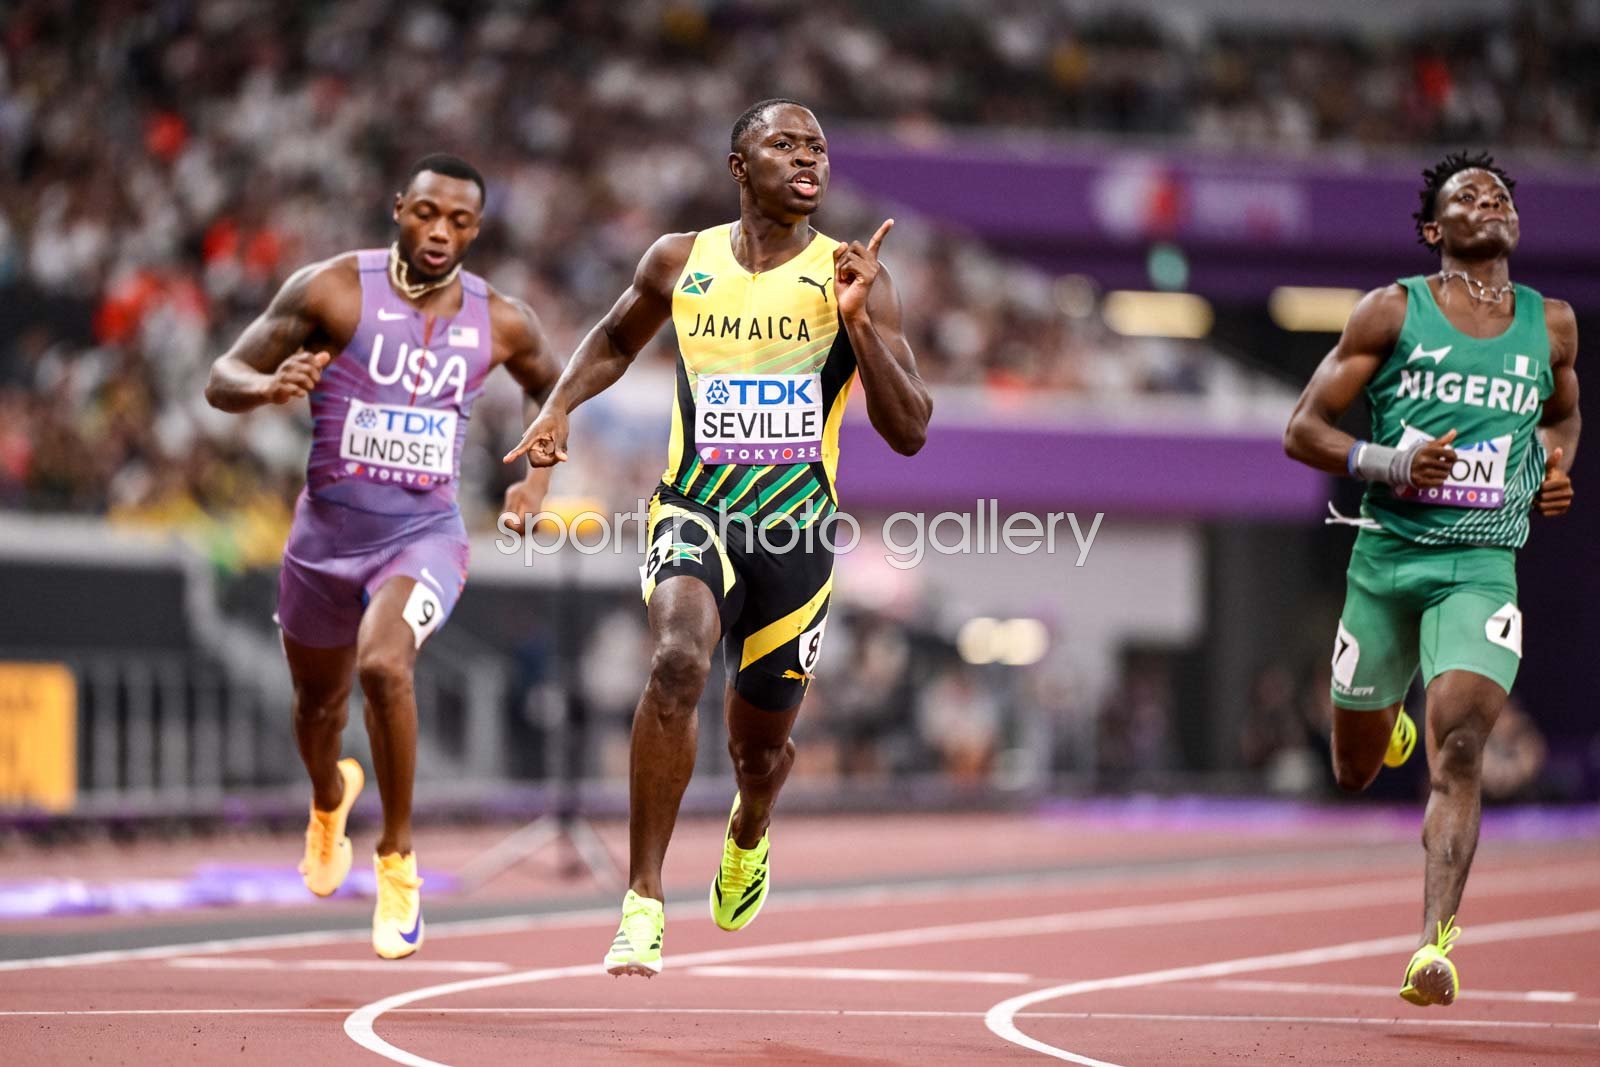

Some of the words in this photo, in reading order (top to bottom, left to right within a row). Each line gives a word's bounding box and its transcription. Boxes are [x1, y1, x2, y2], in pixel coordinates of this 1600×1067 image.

[688, 313, 811, 342] JAMAICA
[368, 333, 467, 404] USA
[729, 379, 814, 406] TDK
[1396, 369, 1539, 416] NIGERIA
[379, 408, 447, 438] TDK
[702, 411, 816, 439] SEVILLE
[349, 433, 448, 468] LINDSEY
[1449, 458, 1494, 484] ON
[646, 546, 661, 579] 8
[417, 600, 435, 627] 9
[805, 631, 821, 668] 8
[1335, 636, 1350, 666] 7
